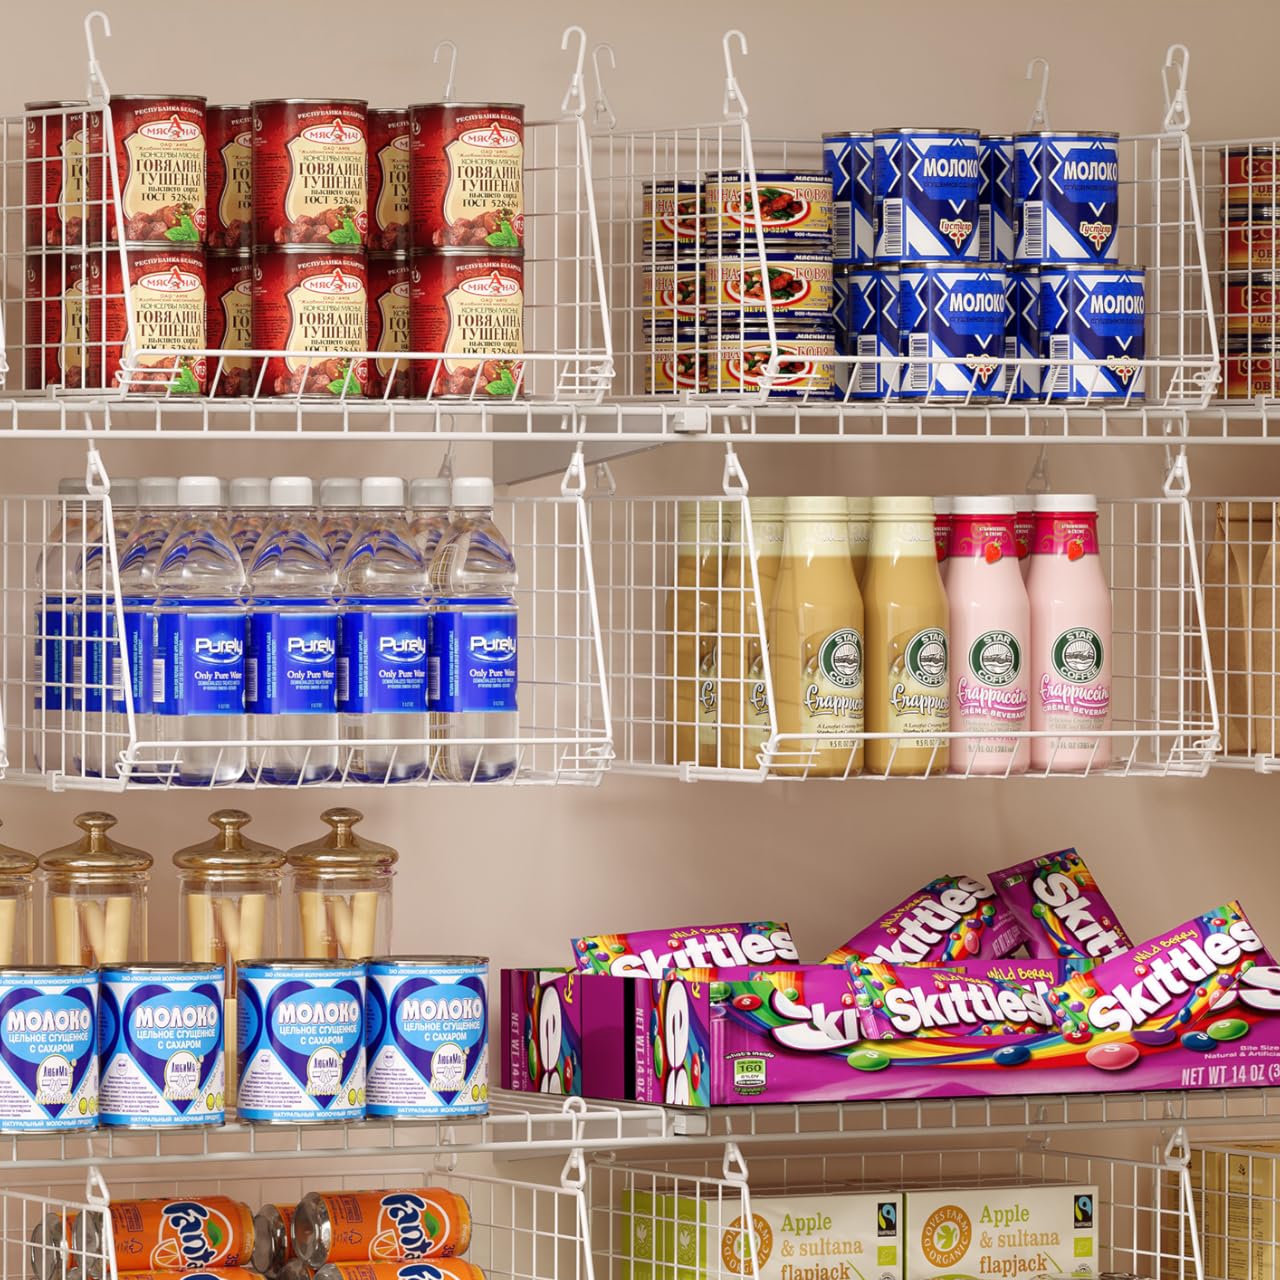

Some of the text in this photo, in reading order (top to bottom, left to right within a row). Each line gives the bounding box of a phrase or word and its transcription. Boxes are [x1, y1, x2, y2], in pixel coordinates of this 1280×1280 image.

[923, 158, 978, 178] МОЛОКО
[1063, 161, 1117, 181] МОЛОКО
[140, 172, 201, 187] ТУШЕНАЯ
[303, 176, 363, 190] ТУШЕНАЯ
[461, 179, 520, 193] ТУШЕНАЯ
[950, 292, 1004, 313] МОЛОКО
[1090, 294, 1145, 314] МОЛОКО
[379, 636, 426, 654] Purely
[983, 634, 1011, 644] STAR
[1066, 630, 1094, 641] STAR
[195, 638, 243, 656] Purely
[288, 637, 335, 655] Purely
[977, 670, 1016, 685] COFFEE
[1060, 666, 1098, 683] COFFEE
[1087, 919, 1265, 1034] Skittles
[135, 1005, 219, 1030] МОЛОКО
[278, 1001, 360, 1025] МОЛОКО
[402, 997, 483, 1021] МОЛОКО
[7, 1009, 92, 1033] МОЛОКО
[136, 1030, 174, 1040] ЦЕЛЬНОЕ
[157, 1040, 201, 1049] С САХАРОМ
[738, 1064, 762, 1073] 160
[1182, 1067, 1205, 1087] NET
[1208, 1067, 1229, 1086] WT
[1232, 1066, 1246, 1084] 14
[1250, 1065, 1265, 1083] OZ
[781, 1212, 832, 1237] Apple
[979, 1204, 1030, 1229] Apple
[800, 1239, 864, 1257] sultana
[979, 1229, 1060, 1249] & sultana
[979, 1254, 1048, 1278] flapjack
